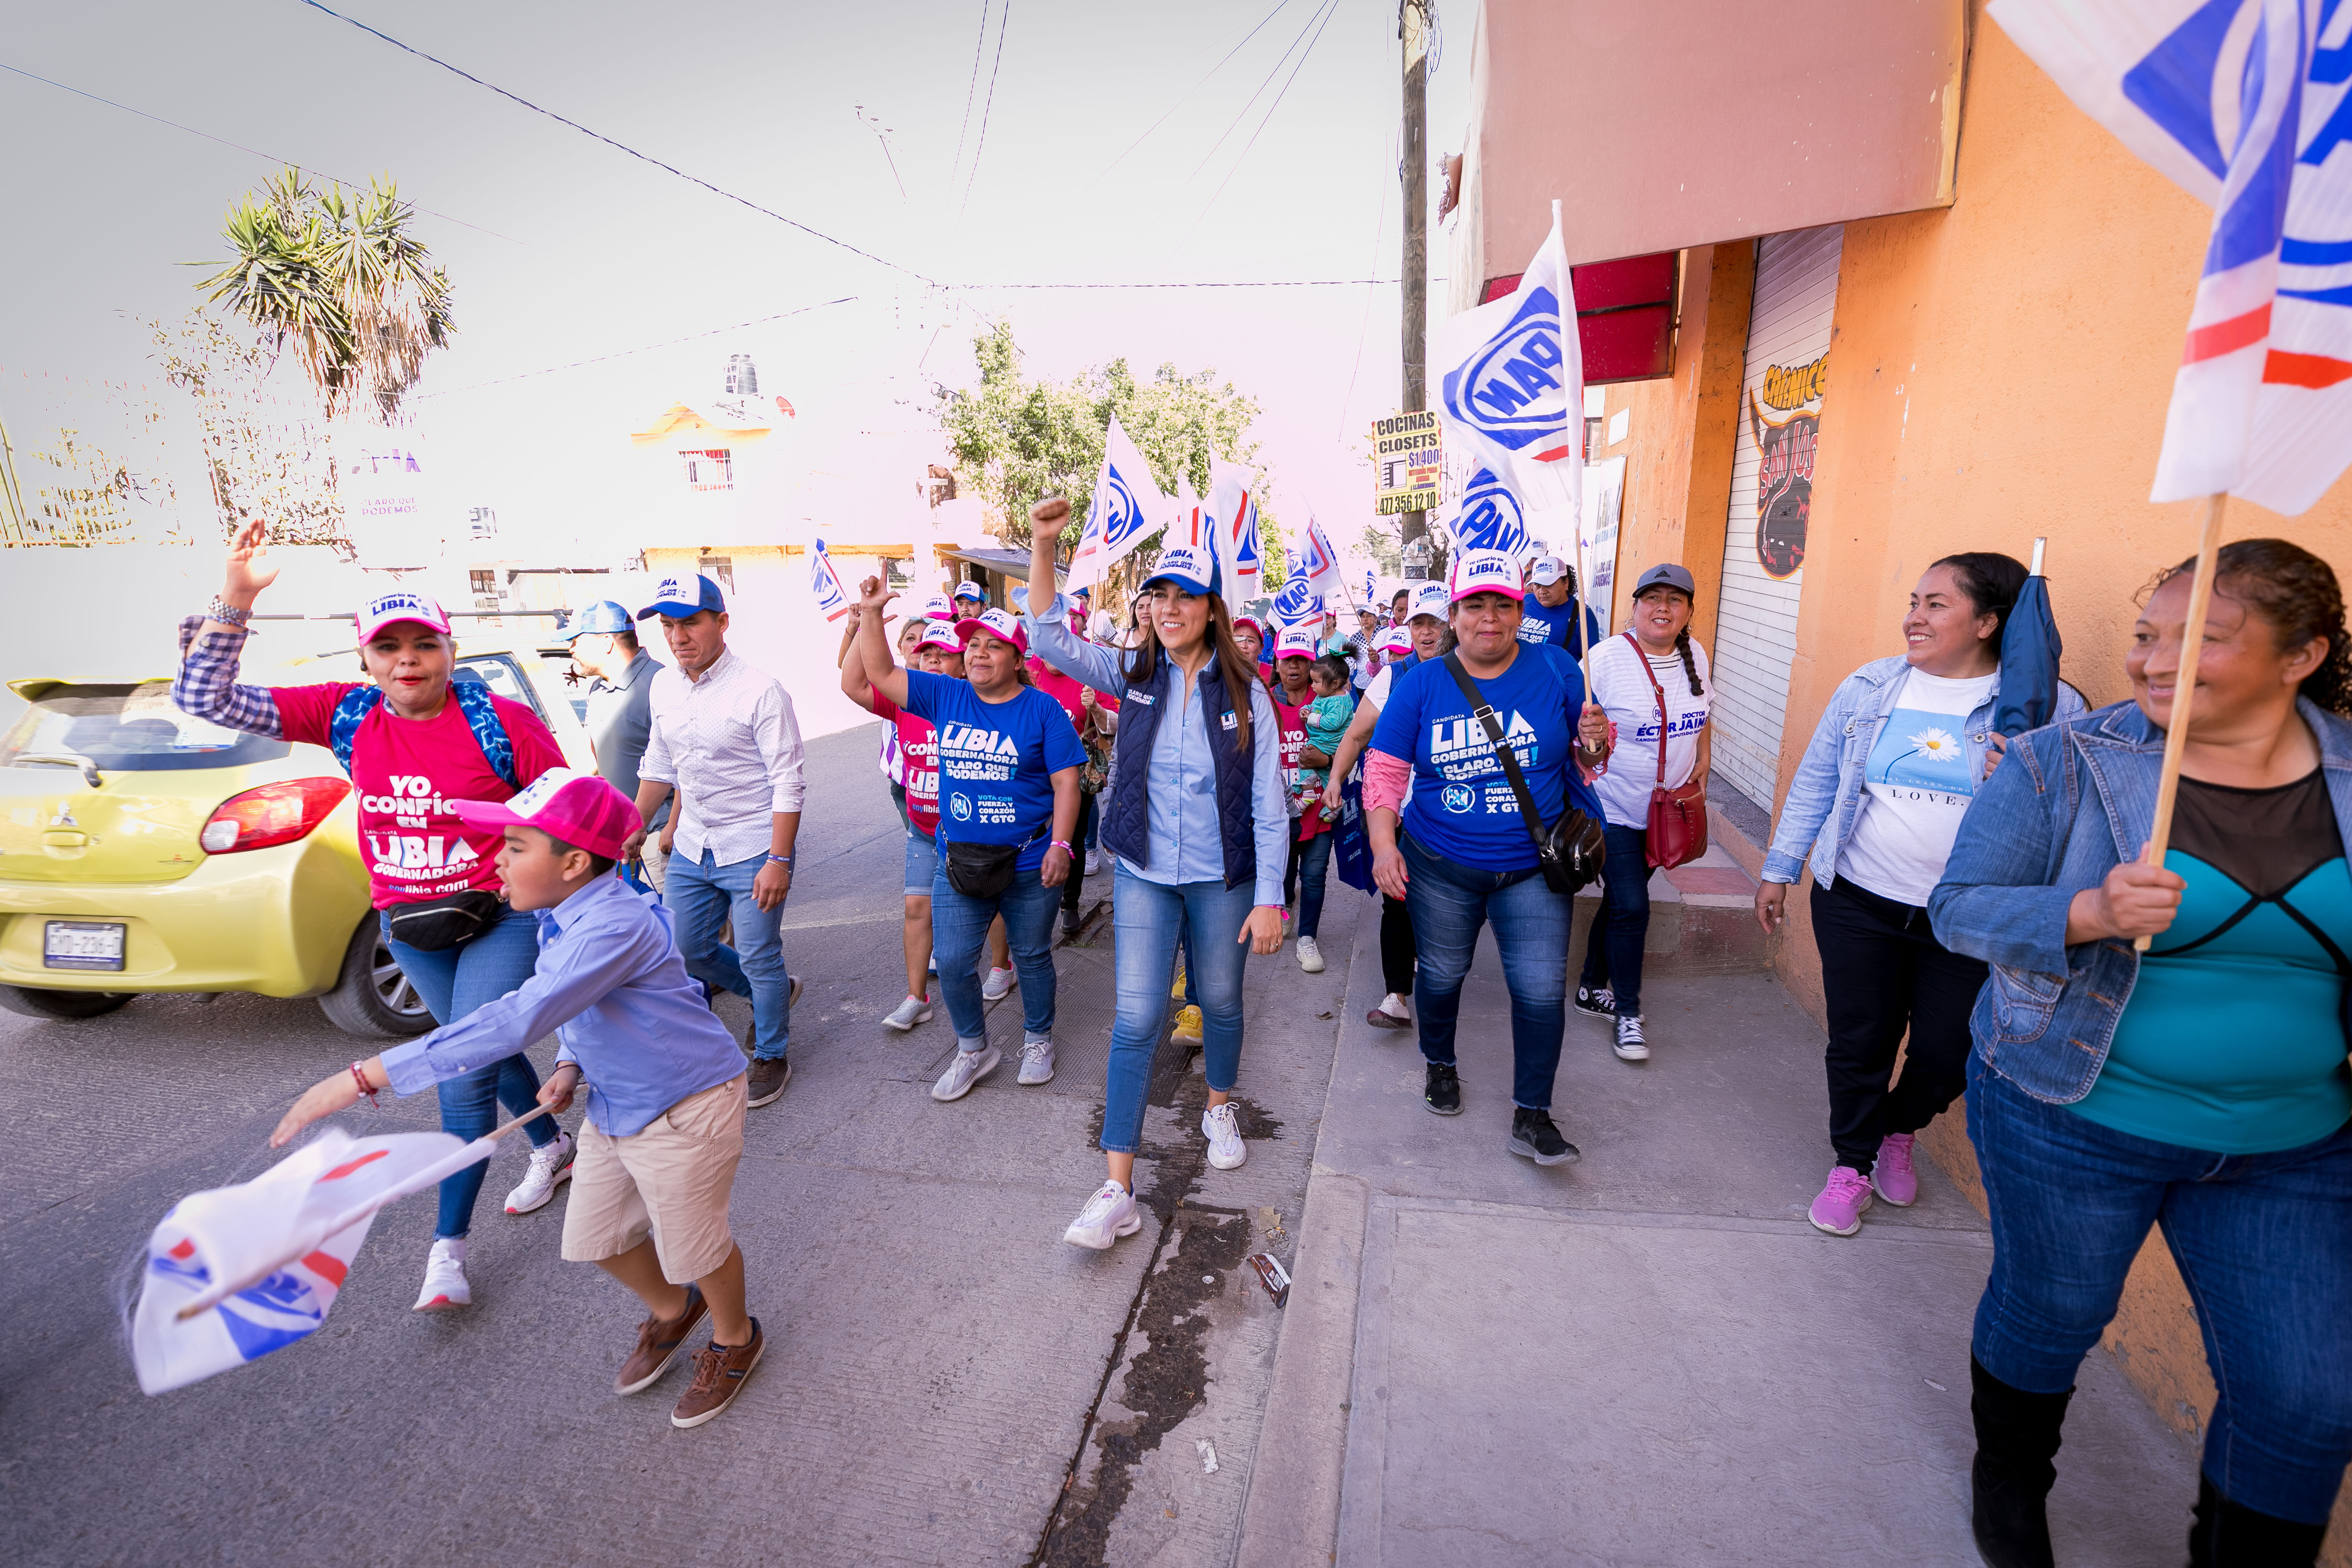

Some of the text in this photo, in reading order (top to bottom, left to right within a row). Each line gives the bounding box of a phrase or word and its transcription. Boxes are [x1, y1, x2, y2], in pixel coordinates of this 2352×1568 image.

[1377, 411, 1435, 436] COCINAS
[1379, 433, 1437, 453] CLOSETS
[1409, 449, 1439, 468] $1,400
[1760, 429, 1788, 499] SAN
[362, 505, 418, 516] PODEMOS
[1380, 491, 1436, 514] 477 356 12 10
[1459, 498, 1520, 552] PAN
[1164, 550, 1194, 559] LIBIA
[1468, 563, 1503, 576] LIBIA
[1420, 586, 1442, 597] LIBIA
[372, 599, 418, 616] LIBIA
[1432, 714, 1465, 724] CANDIDATA
[1682, 711, 1706, 719] DOCTOR
[940, 724, 1019, 756] LIBIA
[940, 748, 1018, 765] GOBERNADORA
[985, 763, 1009, 773] QUE
[389, 776, 431, 797] YO
[1891, 789, 1964, 806] LOVE.
[979, 806, 1016, 814] CORAZÓN
[1486, 803, 1498, 813] X
[396, 816, 427, 829] EN
[980, 814, 1016, 823] X GTO
[366, 835, 479, 868] LIBIA
[373, 860, 478, 880] GOBERNADORA
